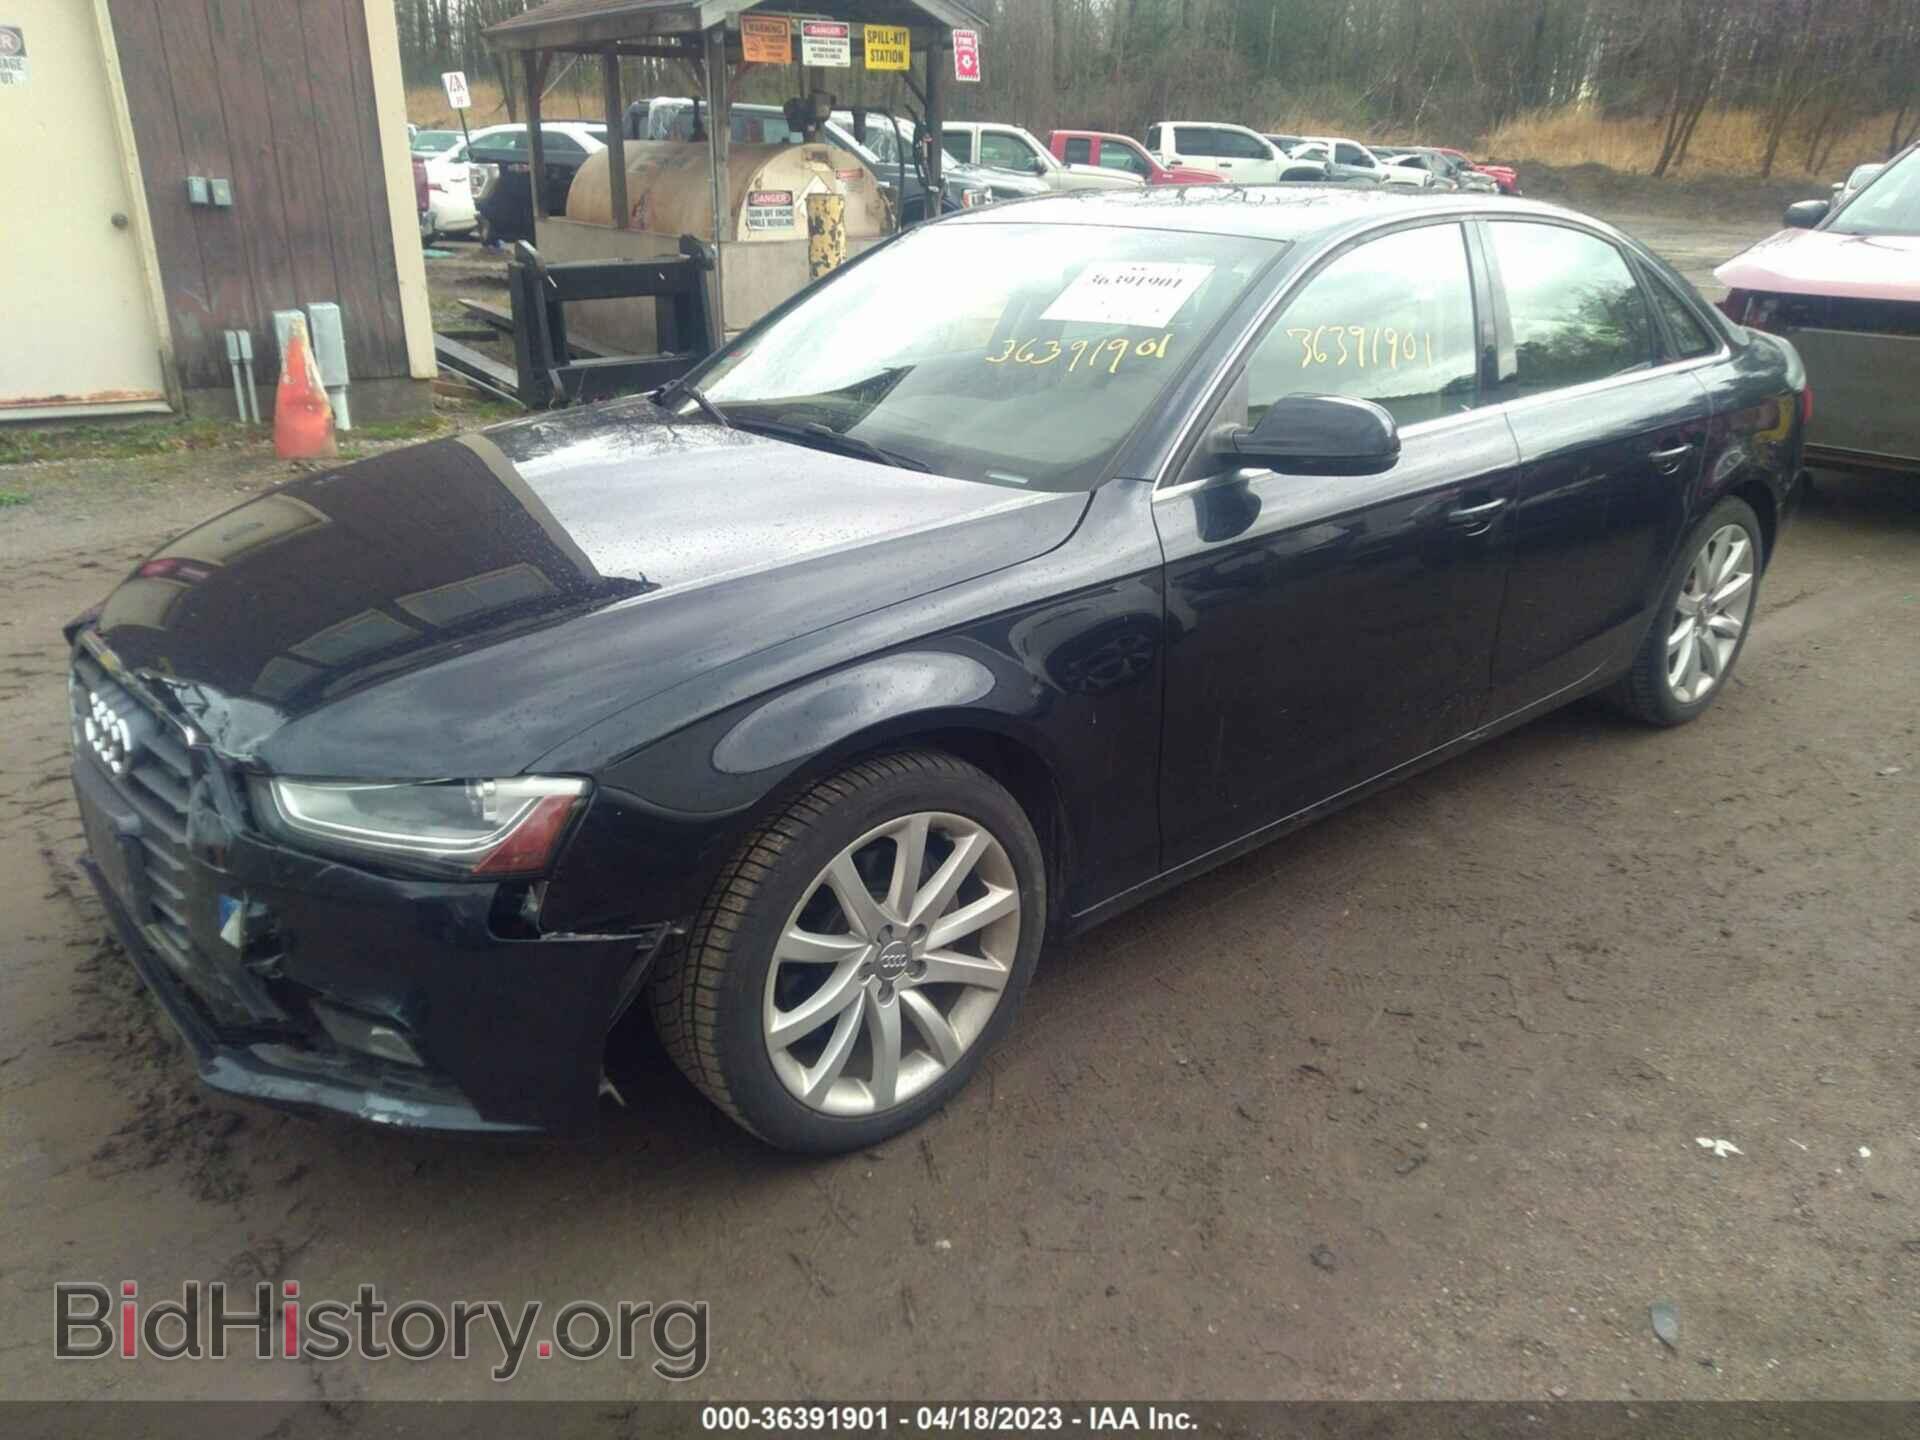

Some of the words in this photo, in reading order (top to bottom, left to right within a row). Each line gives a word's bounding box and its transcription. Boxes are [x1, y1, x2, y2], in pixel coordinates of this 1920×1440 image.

[867, 30, 906, 46] SPILL-KIT
[870, 48, 904, 63] STATION
[753, 193, 790, 204] DANGER
[985, 333, 1174, 374] 36391901
[1286, 325, 1432, 369] 36391901
